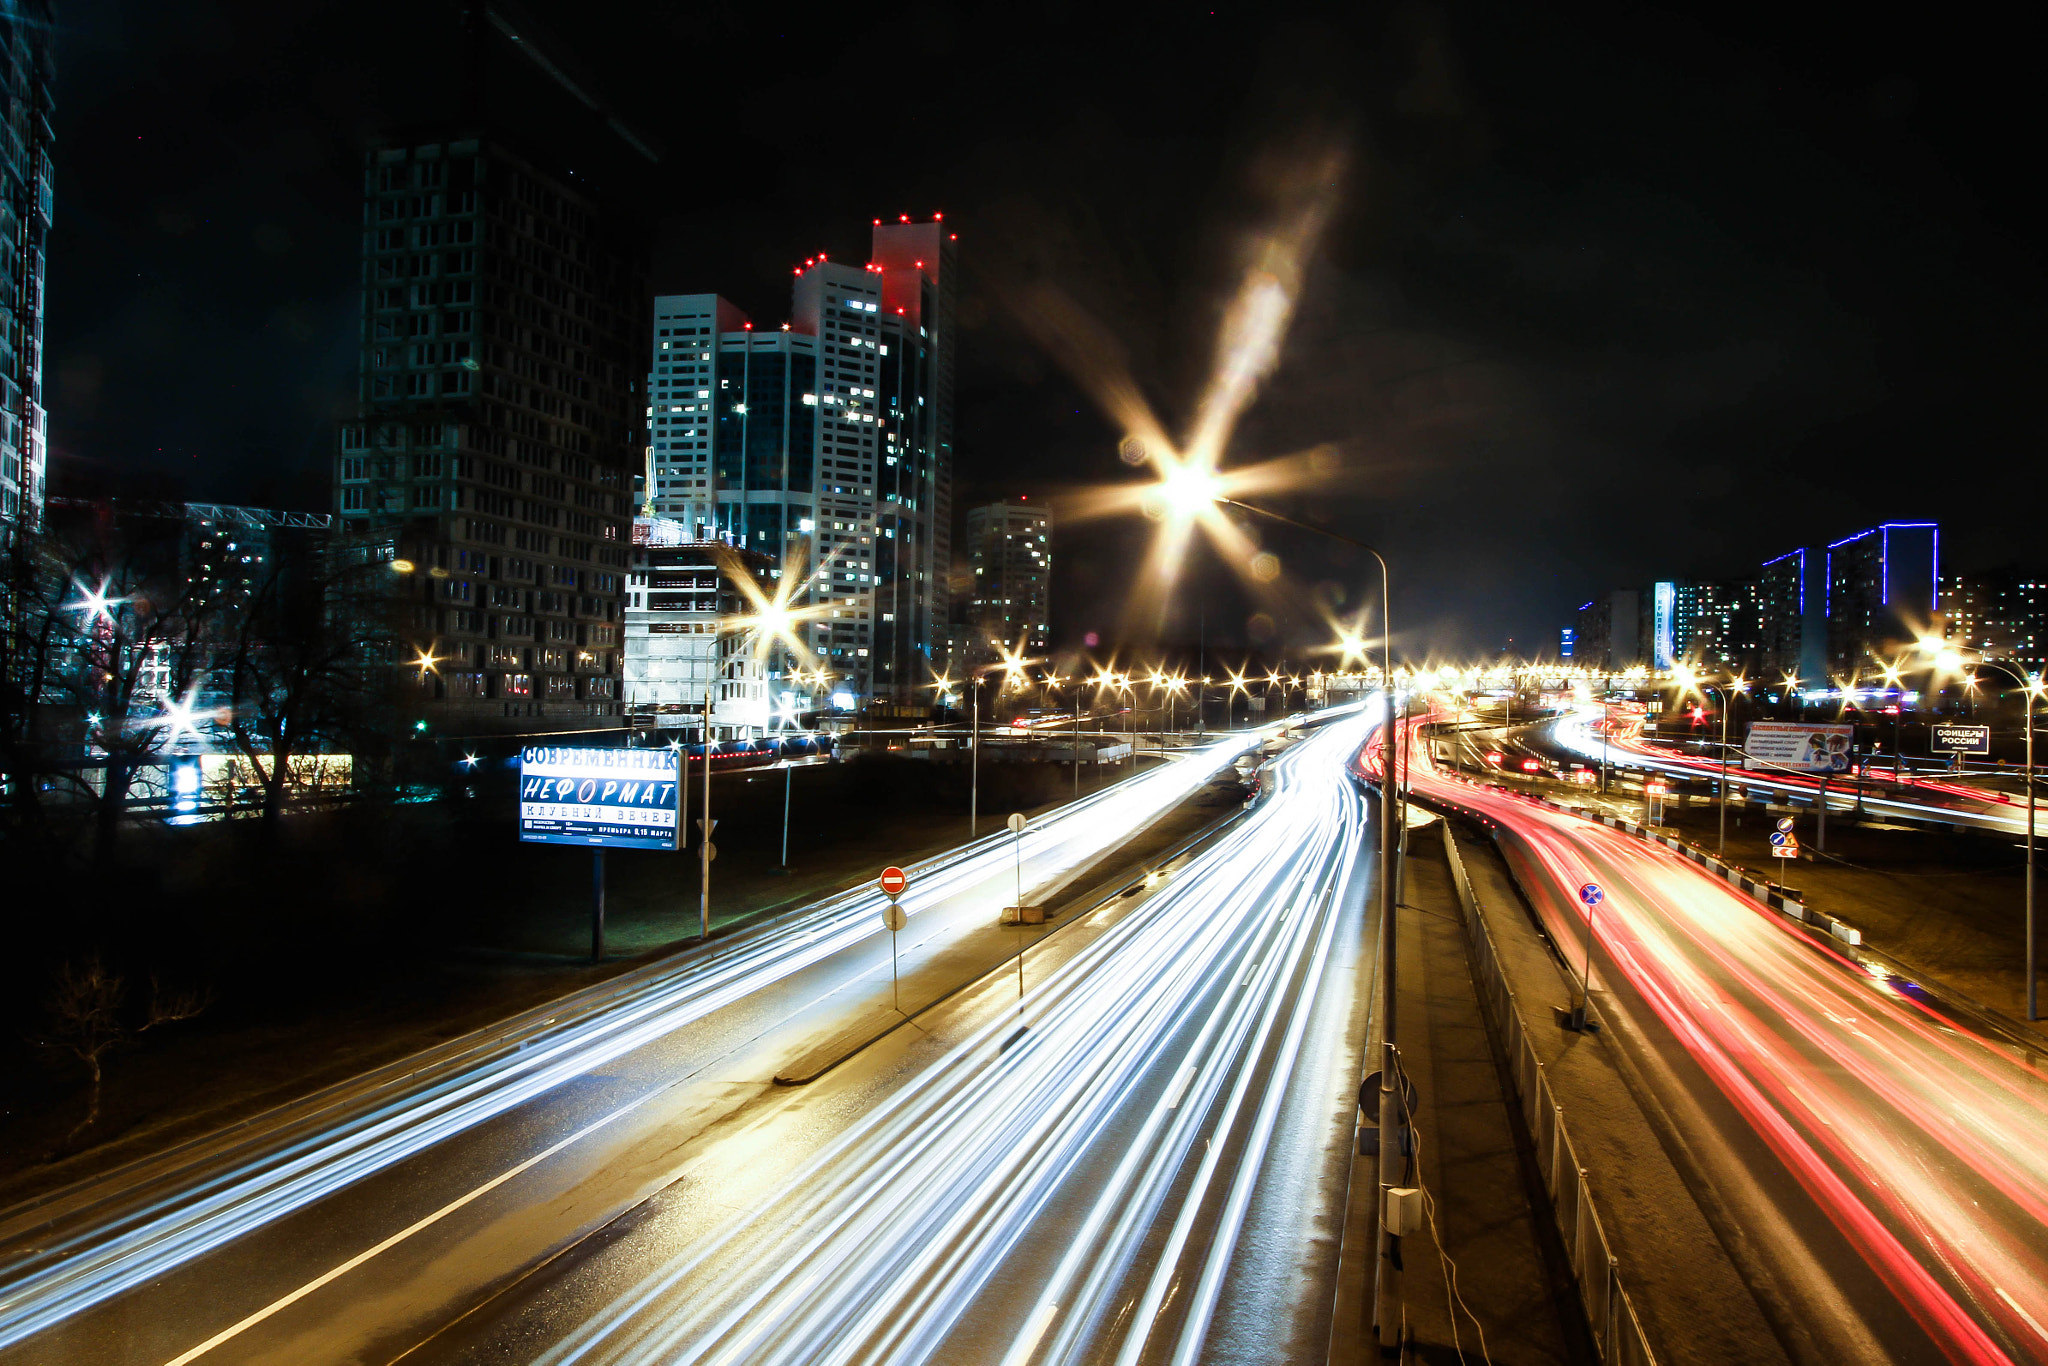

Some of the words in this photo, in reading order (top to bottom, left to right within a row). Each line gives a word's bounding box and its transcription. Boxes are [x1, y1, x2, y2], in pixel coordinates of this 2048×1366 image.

[1937, 730, 1985, 738] ОФИЦЕРЫ
[1942, 737, 1980, 745] РОССИИ
[523, 747, 677, 770] СОВРЕМЕННИК
[523, 778, 675, 805] НЕФОРМАТ
[527, 805, 602, 819] КЛУБНЫЙ
[618, 810, 671, 823] ВЕЧЕР
[598, 826, 631, 835] ПРЕМЬЕРА
[650, 829, 672, 838] МАРТА
